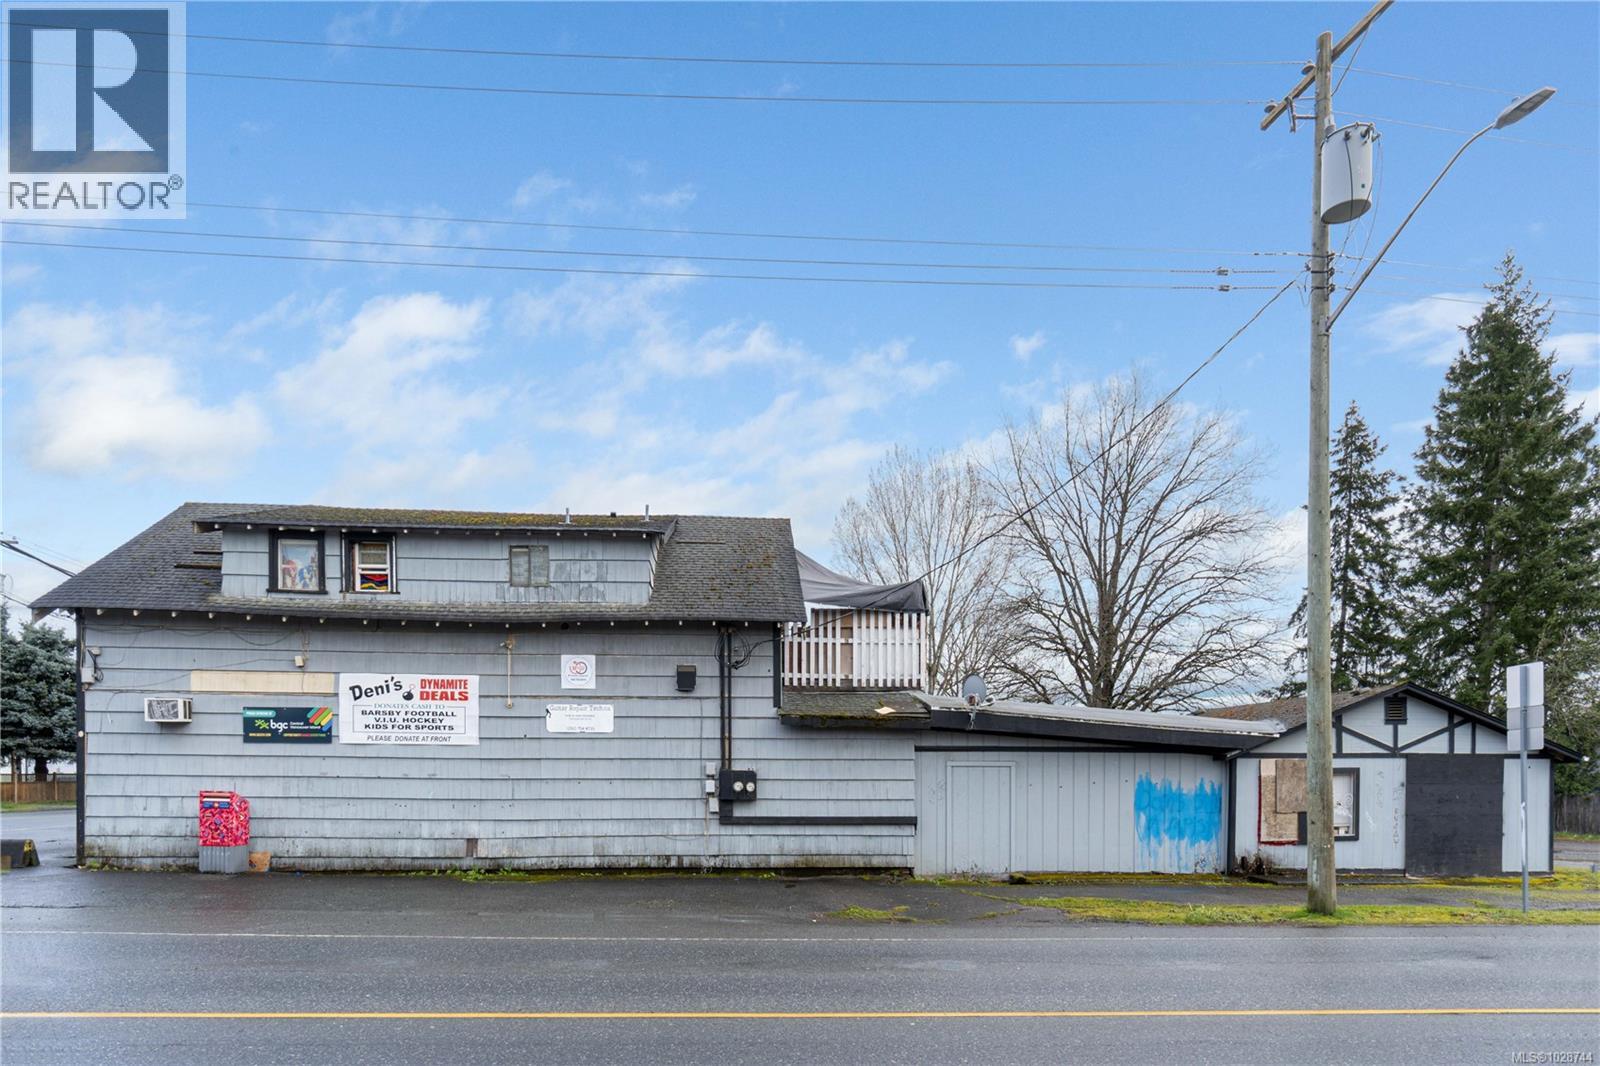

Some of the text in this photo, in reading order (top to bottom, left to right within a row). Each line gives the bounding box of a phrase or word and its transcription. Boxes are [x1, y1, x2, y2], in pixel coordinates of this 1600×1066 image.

[349, 676, 403, 701] Deni's
[420, 679, 468, 690] DYNAMITE
[420, 691, 469, 701] DEALS
[270, 719, 288, 732] bgc
